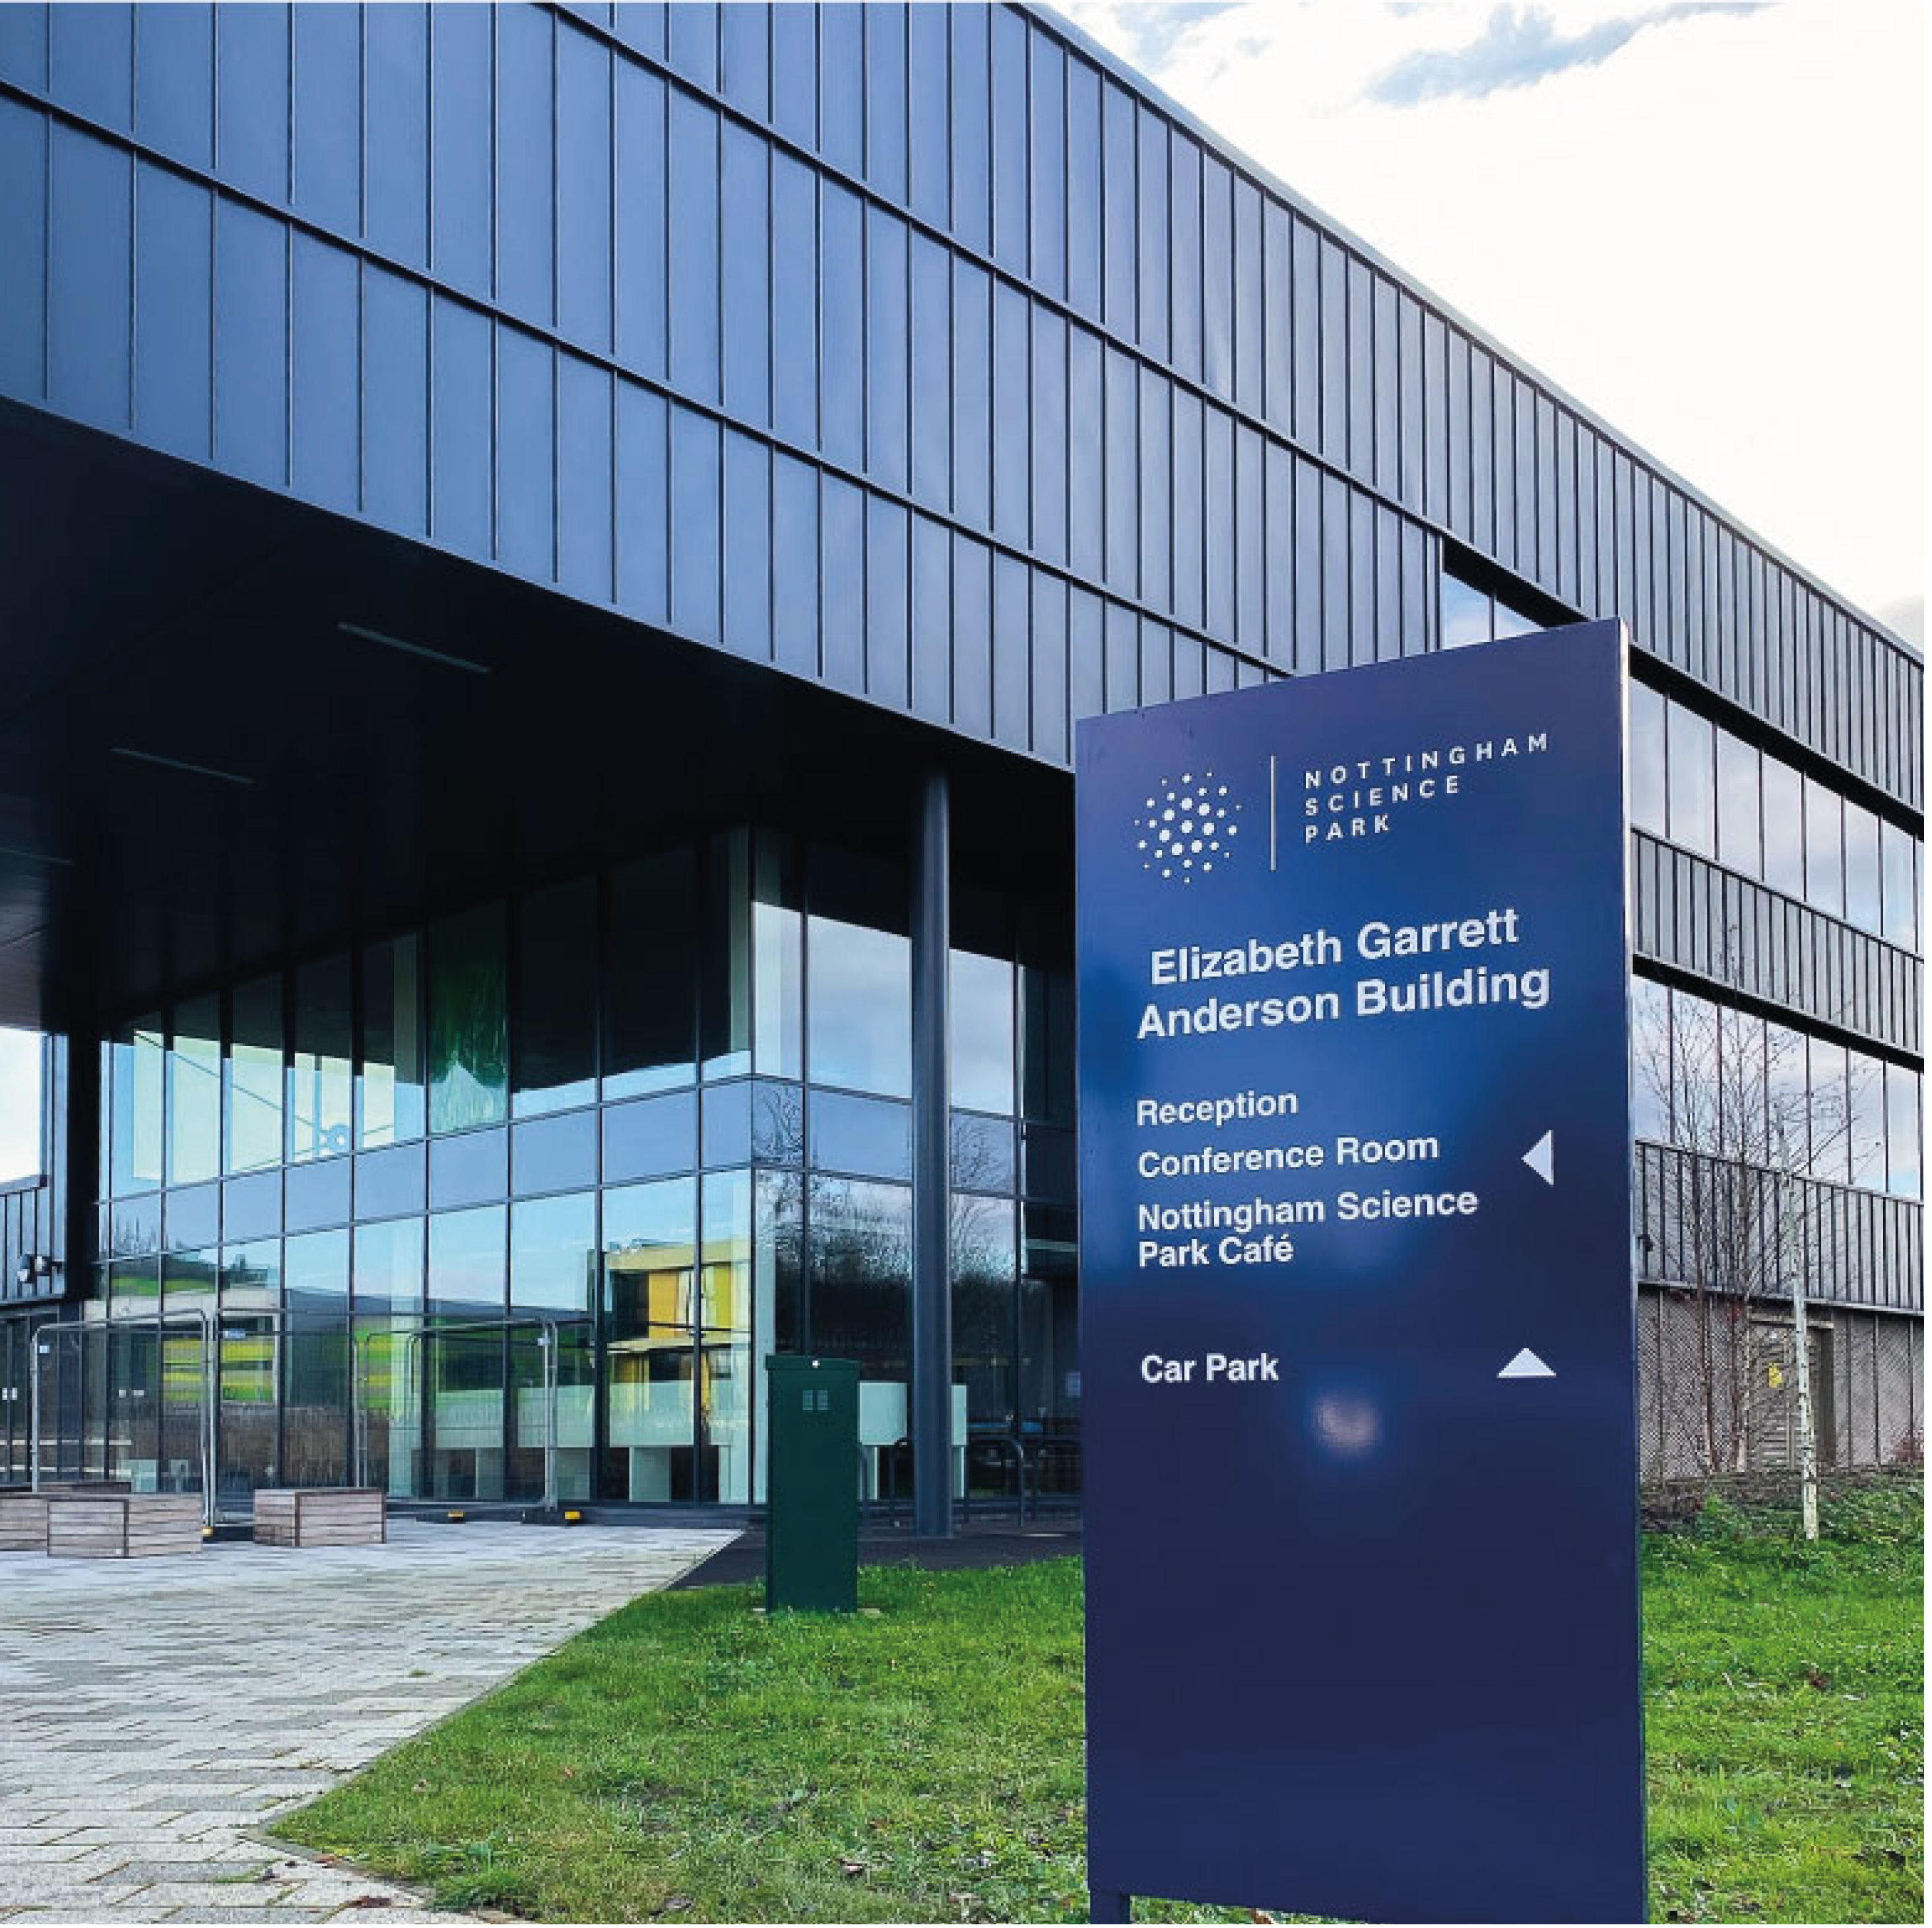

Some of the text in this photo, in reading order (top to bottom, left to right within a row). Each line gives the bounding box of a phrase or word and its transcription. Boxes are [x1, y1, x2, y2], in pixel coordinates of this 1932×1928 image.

[1306, 734, 1546, 788] NOTTINGHAM
[1306, 776, 1457, 816] SCIENCE
[1306, 815, 1389, 843] PARK
[1152, 909, 1519, 984] Elizabeth Garrett
[1137, 967, 1549, 1039] Anderson Building
[1138, 1091, 1299, 1126] Reception
[1140, 1138, 1439, 1177] Conference Room
[1140, 1190, 1479, 1233] Nottingham Science
[1140, 1234, 1293, 1267] Park Café
[1142, 1353, 1279, 1383] Car Park
